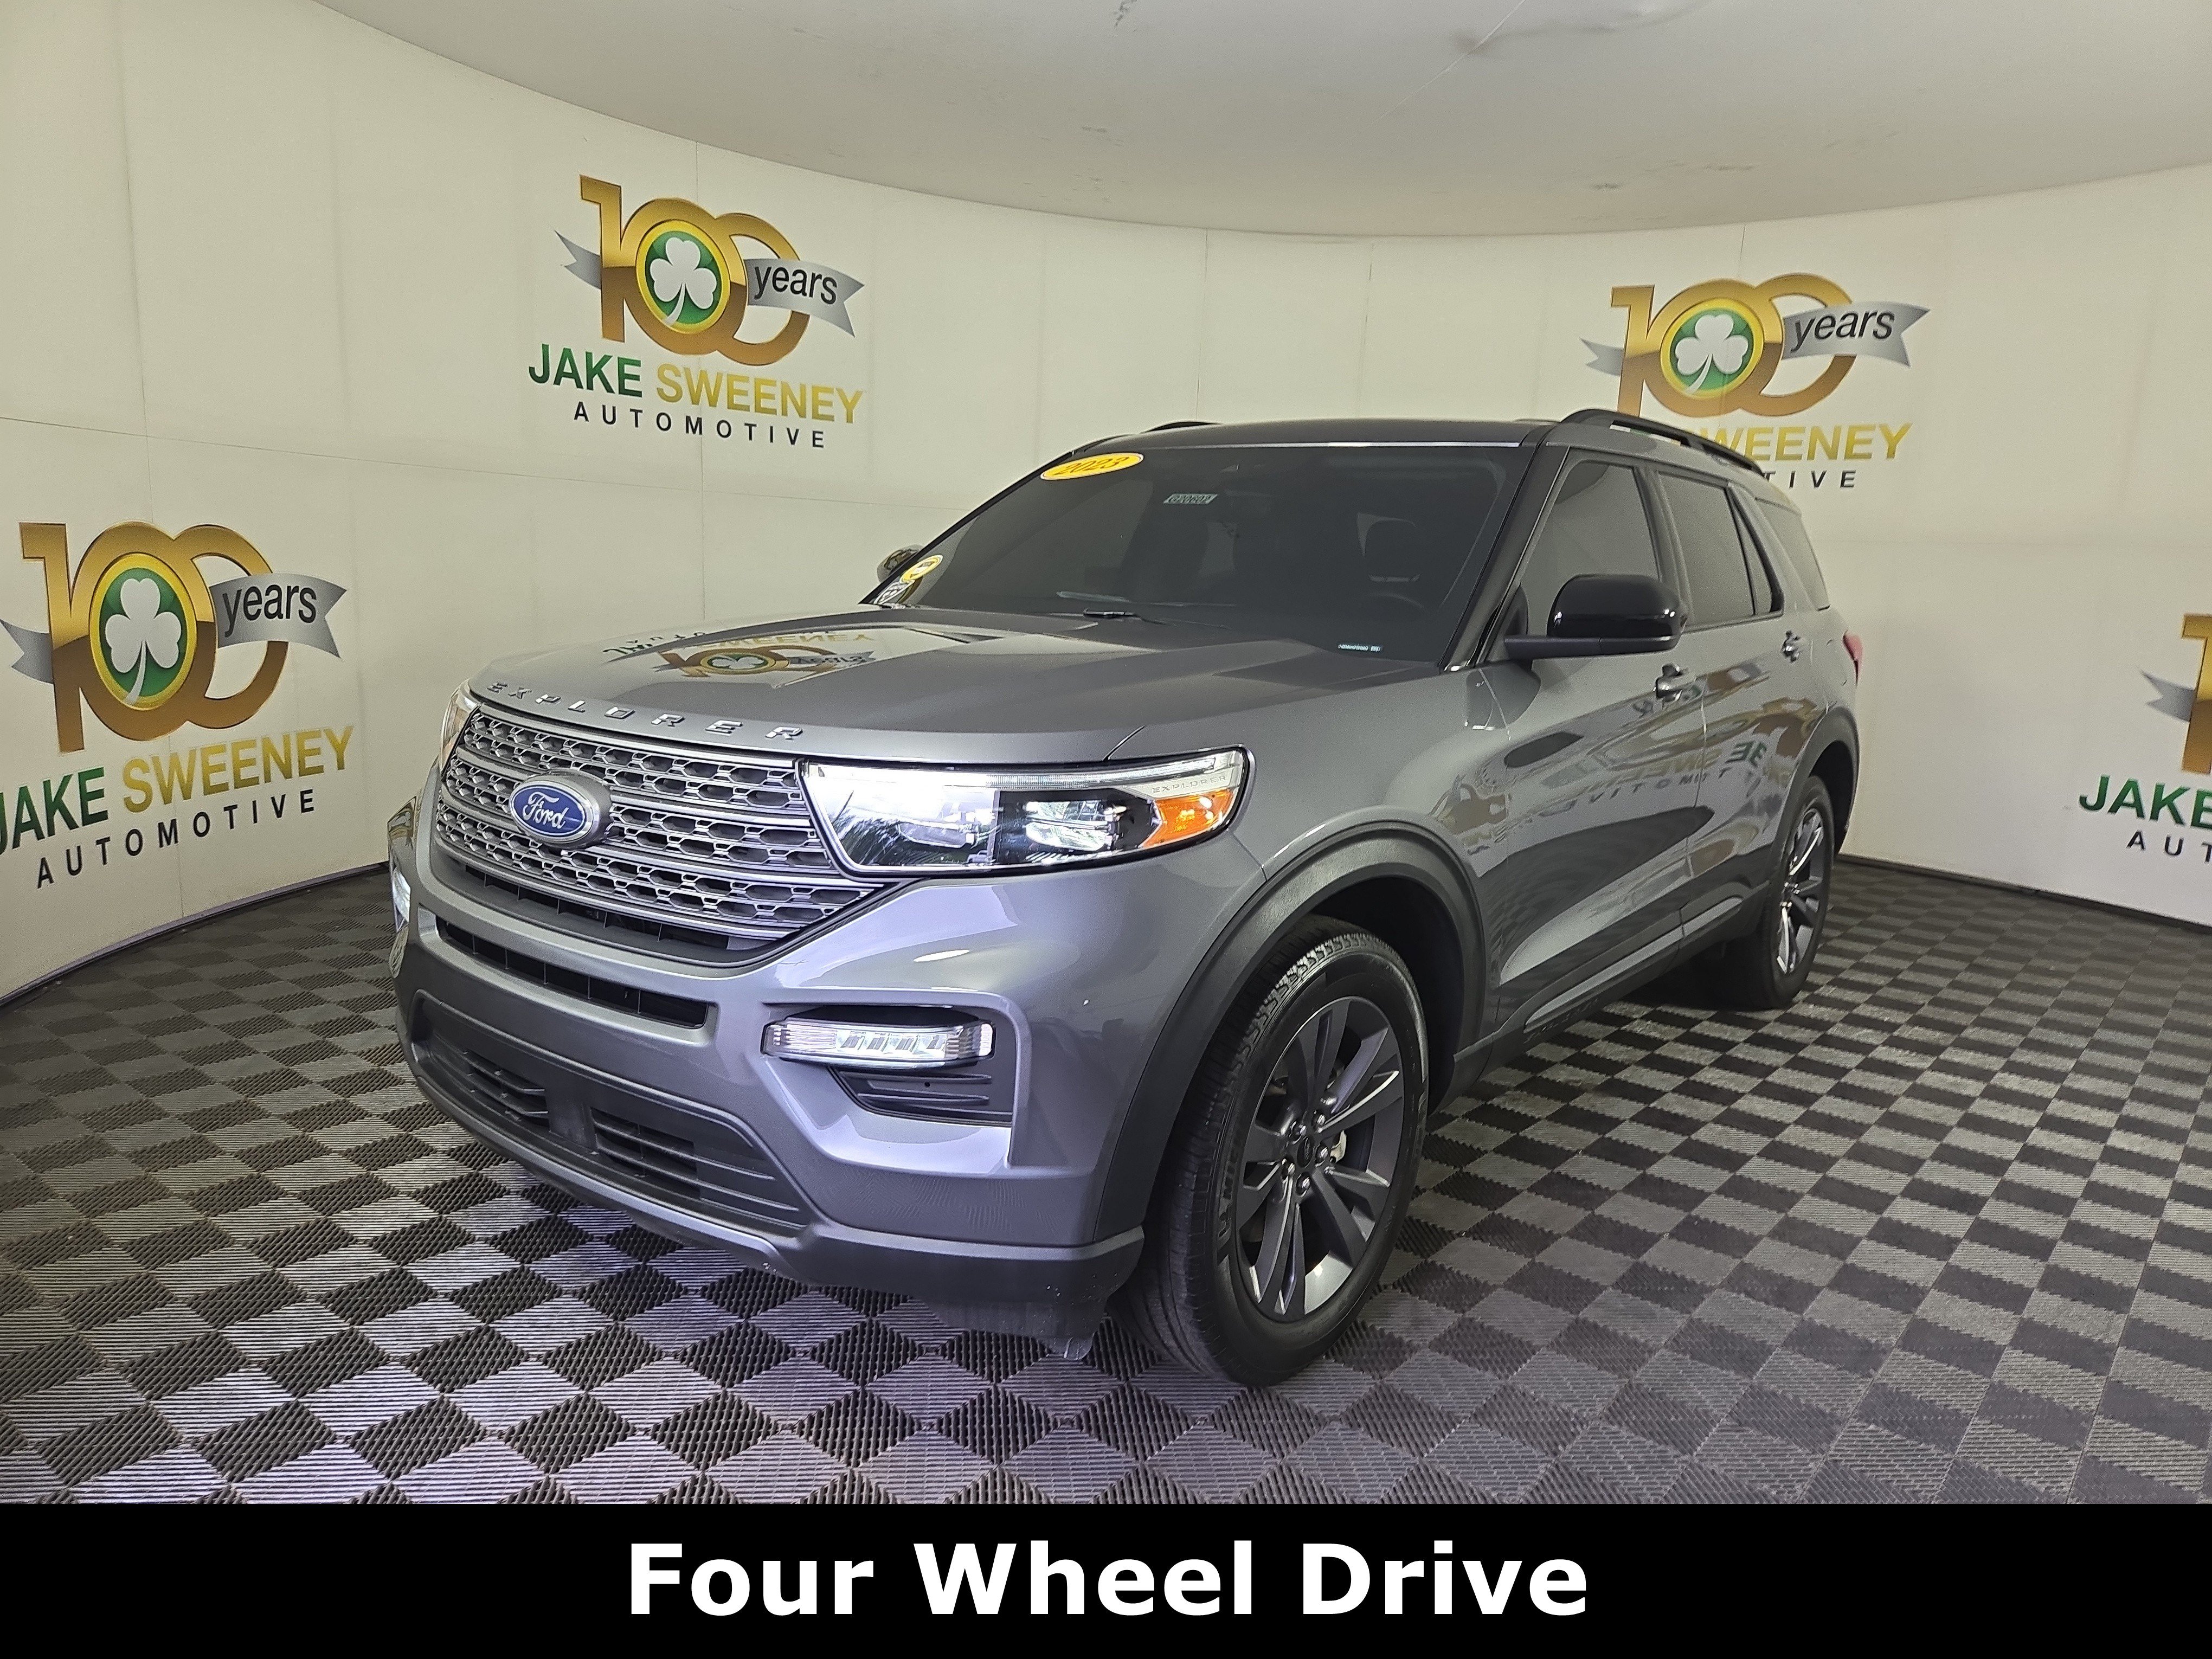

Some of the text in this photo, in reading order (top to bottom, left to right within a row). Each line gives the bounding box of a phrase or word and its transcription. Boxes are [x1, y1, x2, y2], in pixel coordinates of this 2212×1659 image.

[754, 265, 838, 305] years
[1790, 310, 1895, 353] years
[528, 343, 864, 425] JAKE SWEENEY
[574, 401, 825, 448] AUTOMOTIVE
[1698, 422, 1913, 461] WEENEY
[1052, 456, 1130, 476] 2023
[222, 583, 318, 638] years
[487, 681, 803, 741] EXPLORER
[122, 725, 354, 813] SWEENEY
[1152, 775, 1226, 794] EXPLORER
[522, 791, 569, 829] Ford
[2079, 775, 2212, 829] JAKE
[37, 789, 315, 889] AUTOMOTIVE
